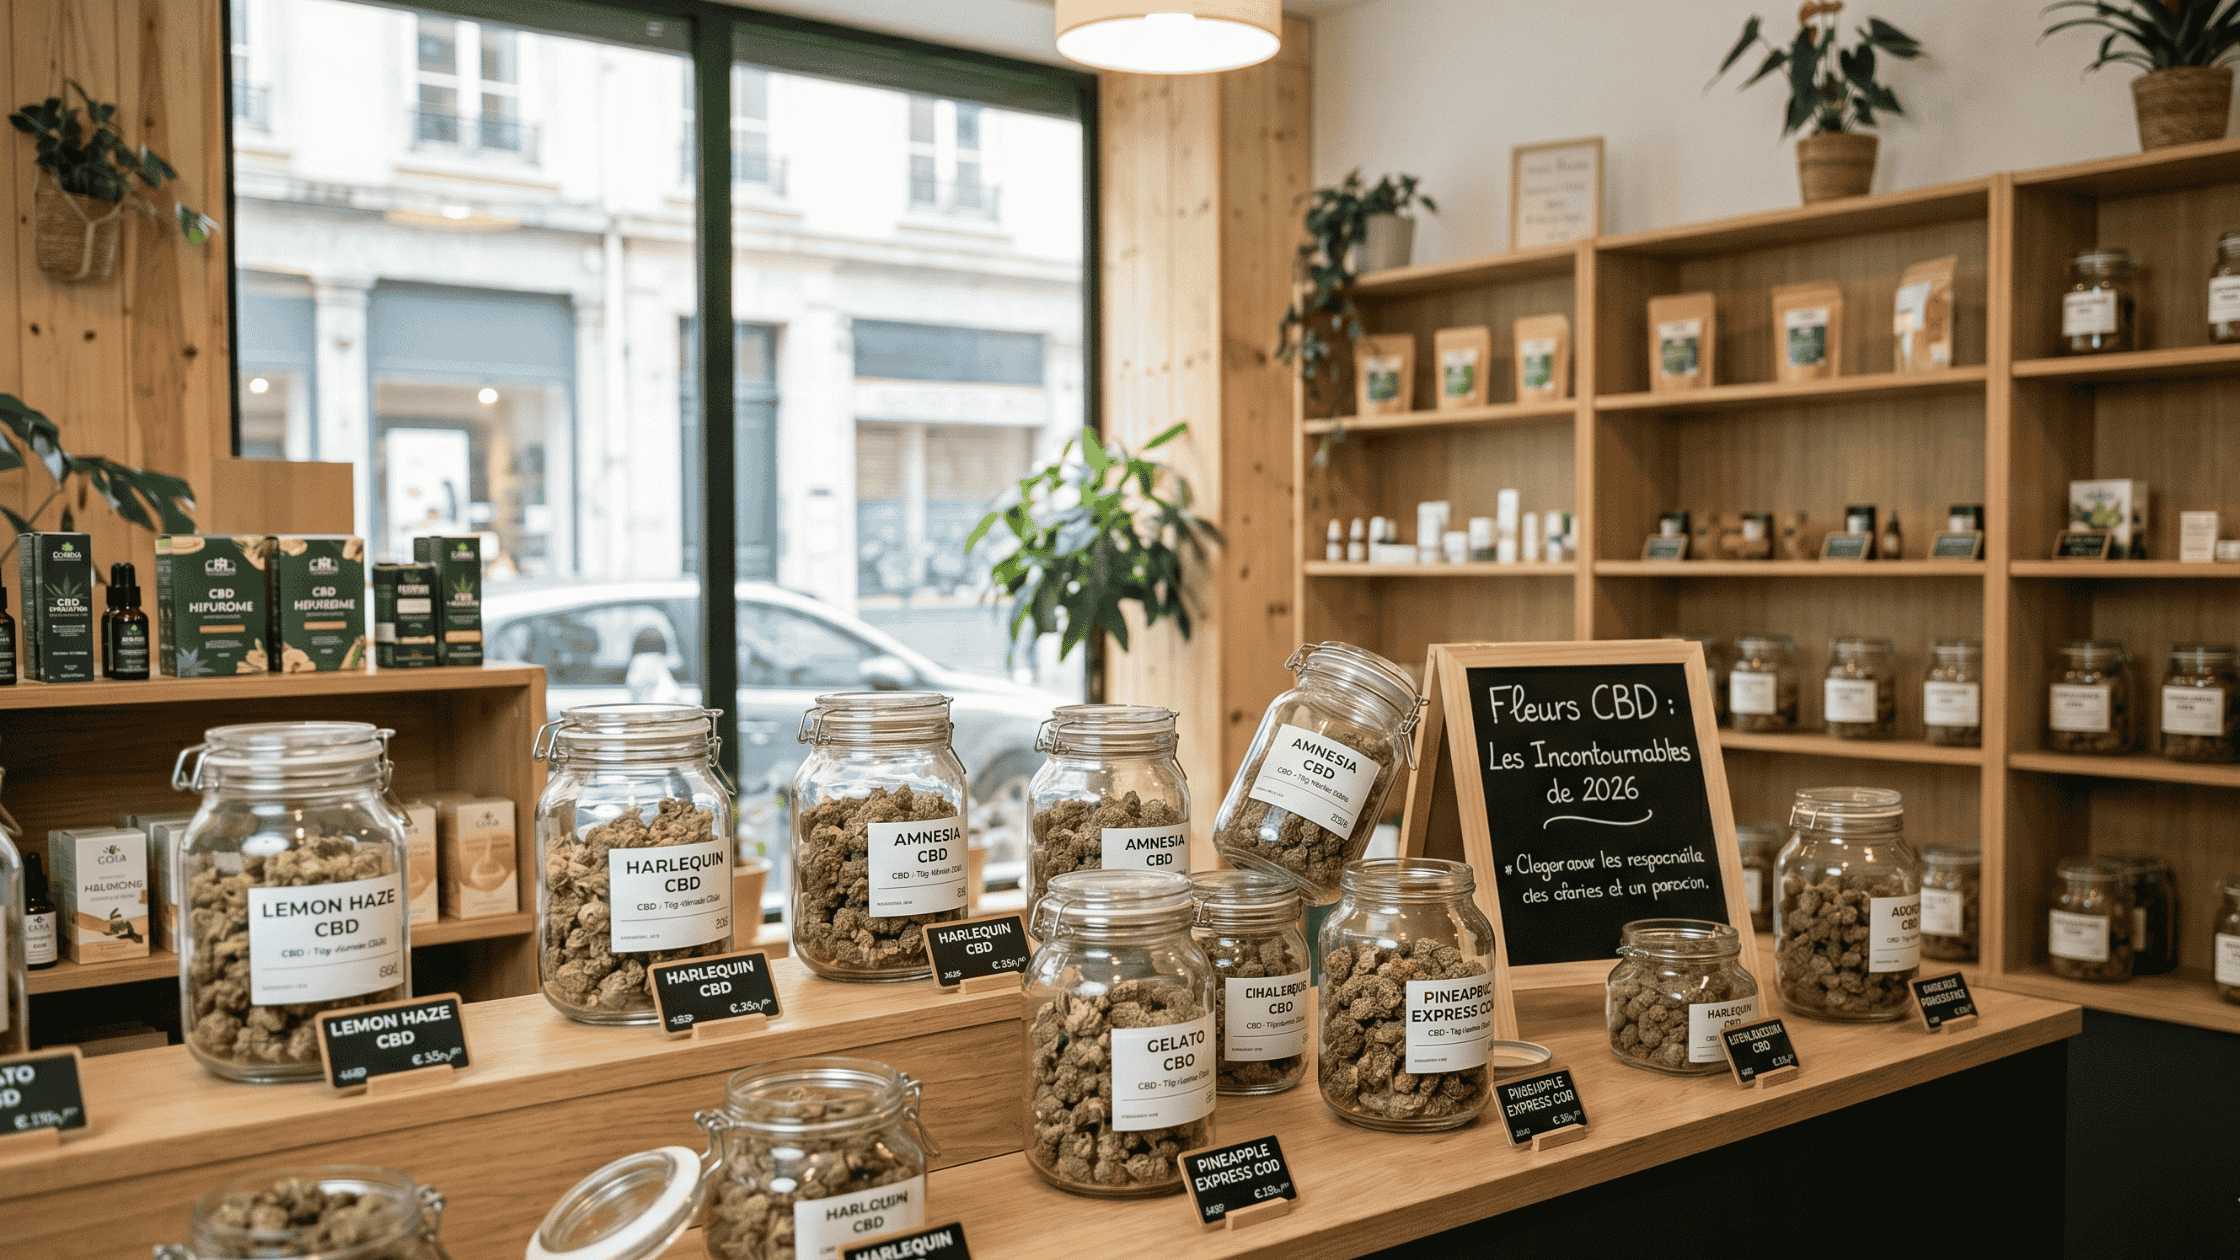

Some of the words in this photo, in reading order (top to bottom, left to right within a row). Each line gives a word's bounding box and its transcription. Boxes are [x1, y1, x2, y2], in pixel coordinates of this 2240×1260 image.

[208, 588, 235, 599] CBD
[312, 586, 337, 597] CBD
[57, 598, 80, 607] CBD
[1489, 684, 1581, 724] Fleurs
[1591, 683, 1658, 720] CBD
[1291, 738, 1358, 774] AMNESIA
[1489, 741, 1525, 770] Les
[1530, 737, 1691, 768] Incontournables
[1303, 759, 1335, 780] CBD
[1546, 778, 1574, 804] de
[1582, 775, 1639, 802] 2026
[894, 827, 961, 846] AMNESIA
[1125, 834, 1185, 851] AMNESIA
[626, 851, 724, 875] HARLEQUIN
[917, 848, 948, 864] CBD
[1146, 853, 1173, 866] CBD
[1600, 850, 1622, 869] les
[664, 876, 701, 893] CBD
[892, 872, 910, 880] CBD
[1608, 878, 1624, 897] et
[262, 898, 342, 918] LEMON
[350, 888, 395, 911] HAZE
[636, 903, 657, 911] CBD
[315, 919, 359, 938] CBD
[938, 922, 1012, 944] HARLEQUIN
[965, 941, 993, 955] CBD
[666, 960, 755, 985] HARLEQUIN
[700, 981, 732, 997] CBD
[1411, 1004, 1478, 1023] EXPRESS
[1707, 1003, 1752, 1019] HARLEQUIN
[329, 1014, 399, 1037] LEMON
[401, 1005, 452, 1025] HAZE
[375, 1031, 416, 1049] CBD
[1147, 1030, 1205, 1053] GELATO
[1428, 1028, 1446, 1037] CBD
[1138, 1082, 1157, 1091] CBD
[1506, 1095, 1552, 1117] EXPRESS
[1197, 1143, 1271, 1173] PINEAPPLE
[1195, 1162, 1253, 1192] EXPRESS
[852, 1216, 884, 1233] CBD
